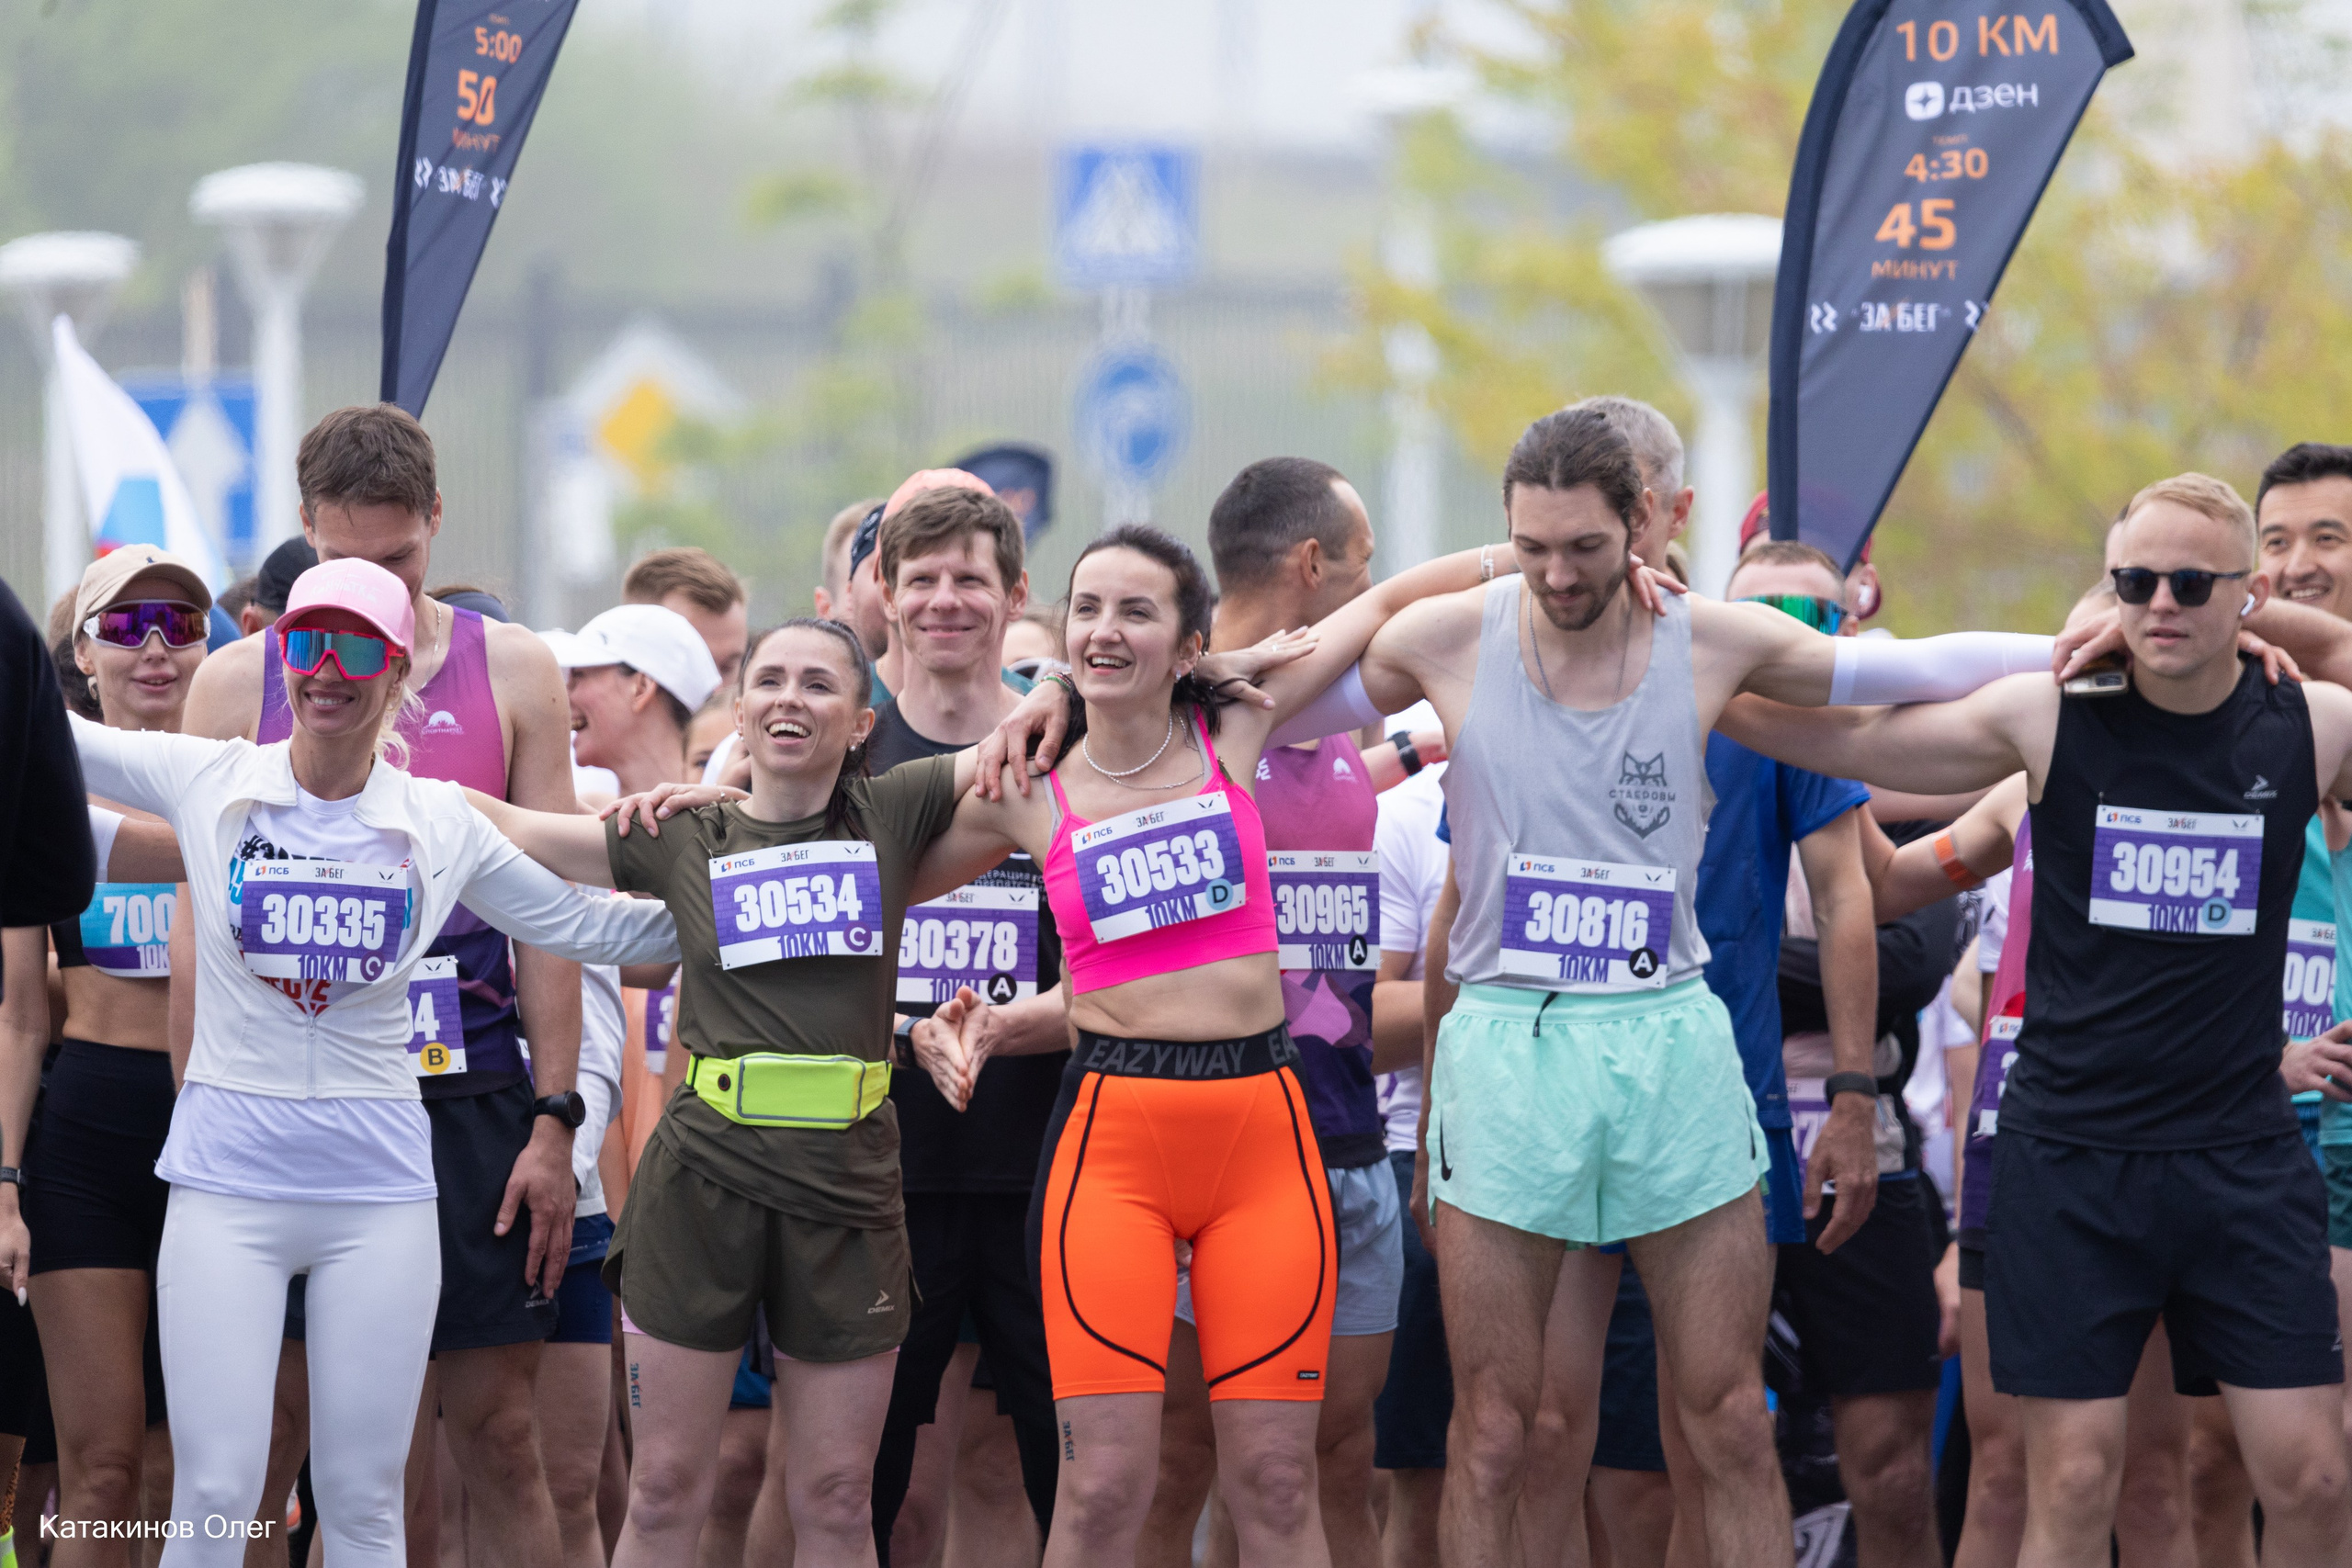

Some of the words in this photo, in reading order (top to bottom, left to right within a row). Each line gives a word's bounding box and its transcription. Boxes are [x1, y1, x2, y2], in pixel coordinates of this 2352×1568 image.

[475, 26, 522, 64] 5:00
[1896, 20, 1959, 62] 10
[457, 69, 497, 126] 50
[1949, 83, 2039, 114] дзен
[1905, 148, 1989, 183] 4:30
[1875, 198, 1957, 251] 45
[2120, 813, 2142, 824] ПСБ
[1093, 827, 1113, 839] ПСБ
[268, 866, 289, 875] ПСБ
[734, 858, 755, 869] ПСБ
[1096, 829, 1225, 905] 30533
[1279, 857, 1296, 865] ПСБ
[1533, 863, 1555, 873] ПСБ
[2109, 840, 2241, 899] 30954
[733, 874, 863, 932] 30534
[1212, 885, 1229, 904] D
[103, 892, 176, 944] 700
[261, 893, 386, 951] 30335
[1145, 895, 1198, 930] 10KM
[1276, 884, 1369, 934] 30965
[1525, 890, 1650, 952] 30816
[2208, 904, 2227, 922] D
[777, 931, 830, 959] 10KM
[849, 927, 866, 946] C
[898, 918, 1018, 971] 30378
[1351, 939, 1365, 960] A
[298, 954, 348, 982] 10KM
[365, 956, 382, 976] C
[1308, 943, 1346, 970] 10KM
[1558, 953, 1608, 984] 10KM
[1633, 951, 1654, 972] A
[991, 976, 1012, 998] A
[427, 1048, 444, 1066] B
[1083, 1039, 1247, 1077] EAZYWAY
[867, 1304, 896, 1314] DEMIX
